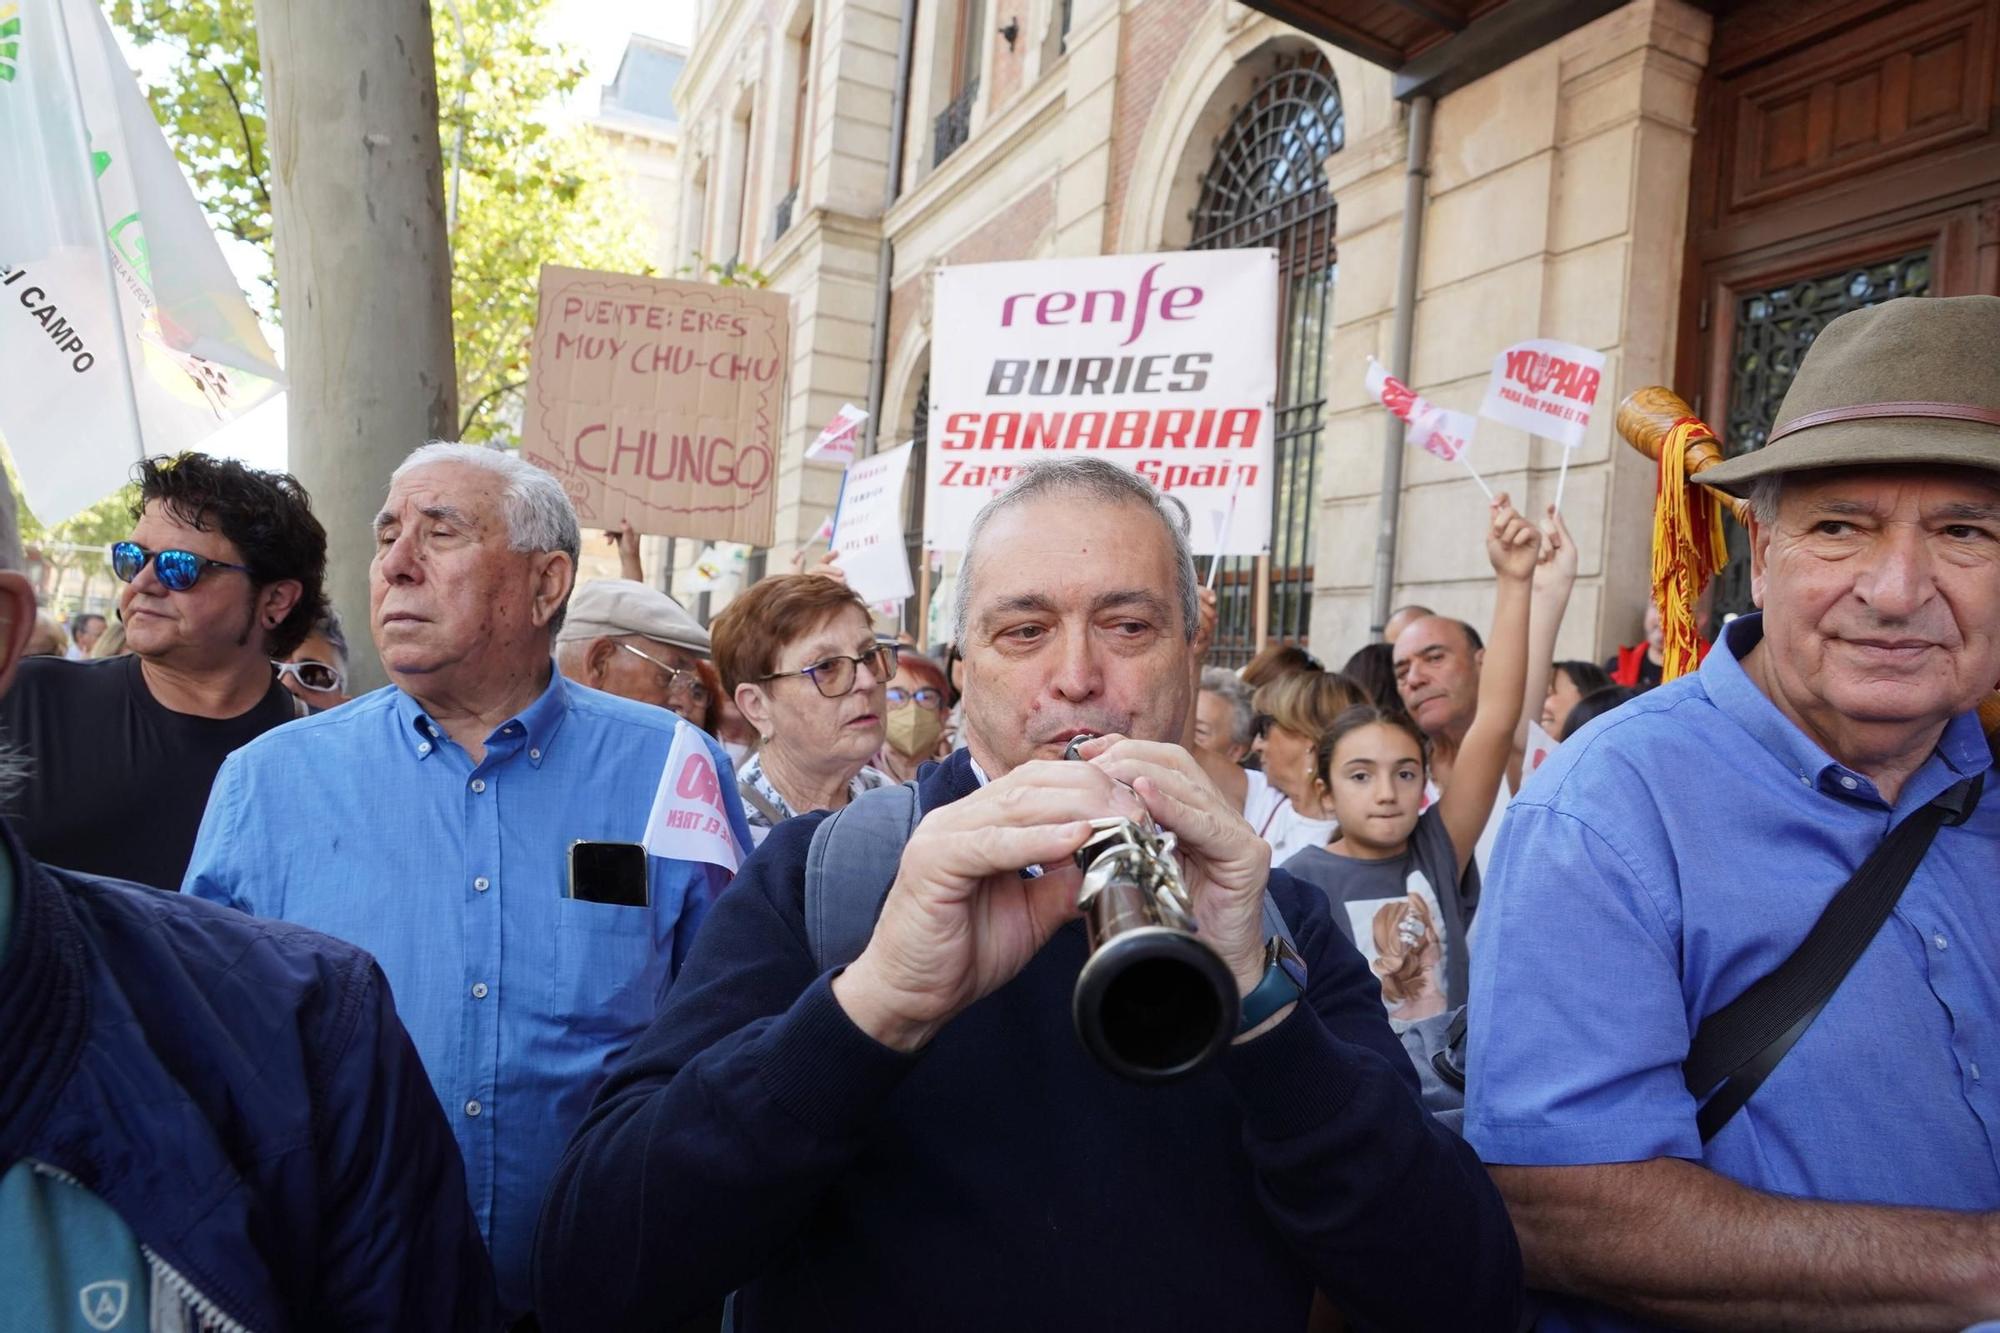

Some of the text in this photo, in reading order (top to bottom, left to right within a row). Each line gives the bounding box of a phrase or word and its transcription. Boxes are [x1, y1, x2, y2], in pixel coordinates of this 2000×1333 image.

[680, 309, 748, 337] ERES
[1000, 262, 1204, 347] renfe
[20, 286, 94, 373] CAMPO
[555, 332, 779, 382] MUY CHU-CHU
[985, 352, 1213, 396] BURIES
[940, 408, 1262, 450] SANABRIA
[574, 424, 772, 490] CHUNGO
[1135, 458, 1258, 491] Spain
